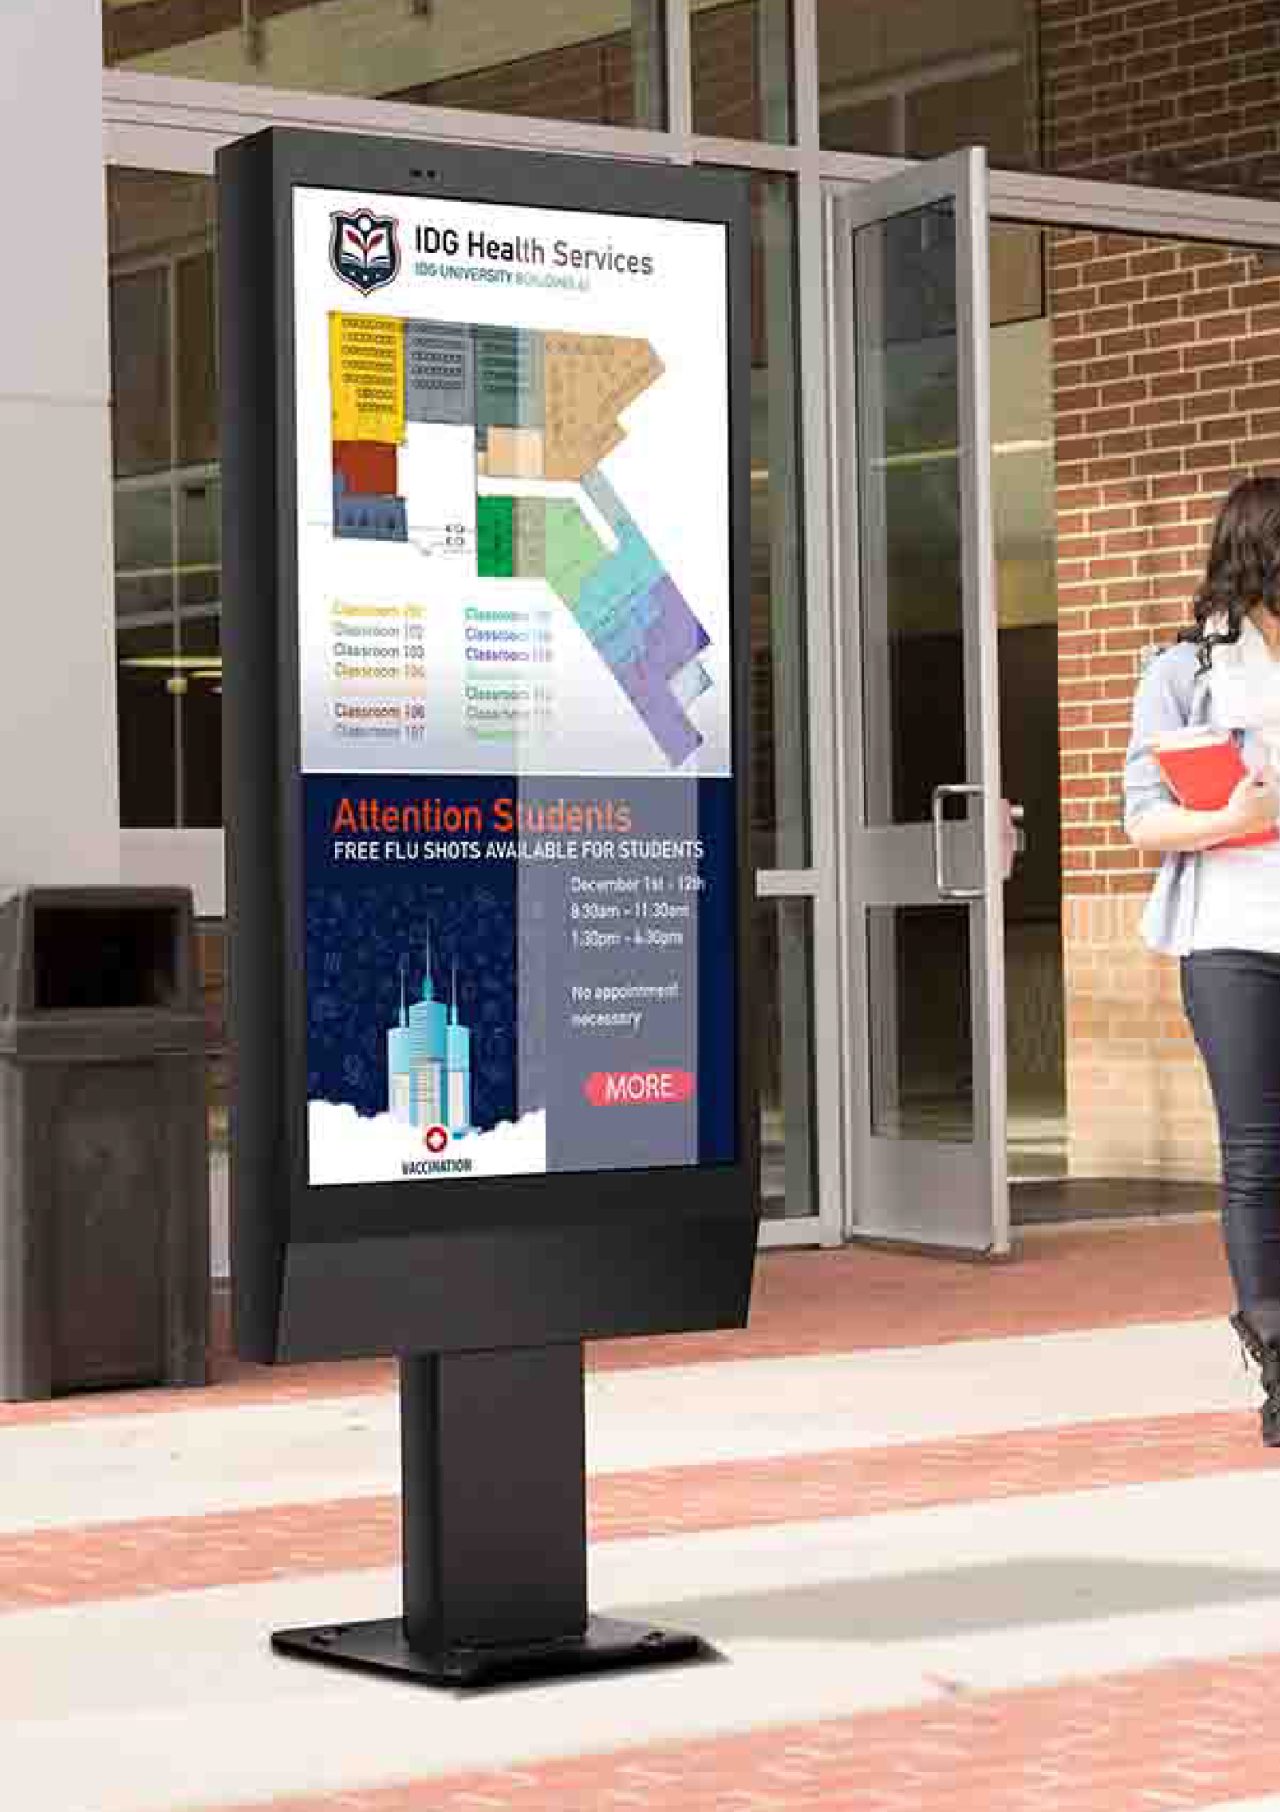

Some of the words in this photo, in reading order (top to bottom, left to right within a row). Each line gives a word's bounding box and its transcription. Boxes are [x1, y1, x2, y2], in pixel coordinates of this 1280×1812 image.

[415, 224, 459, 256] IDG
[468, 230, 545, 265] Health
[553, 237, 654, 275] Services
[415, 262, 437, 277] IDG
[440, 263, 512, 284] UNIVERSITY
[333, 798, 482, 833] Attention
[493, 798, 632, 833] Students
[334, 841, 380, 860] FREE
[385, 841, 419, 859] FLU
[423, 841, 481, 859] SHOTS
[486, 840, 577, 859] AVAILABLE
[581, 840, 615, 859] FOR
[618, 840, 704, 859] STUDENTS
[571, 875, 638, 892] December
[571, 986, 591, 1000] No
[606, 1072, 673, 1100] MORE
[402, 1158, 473, 1176] VACCINATION
